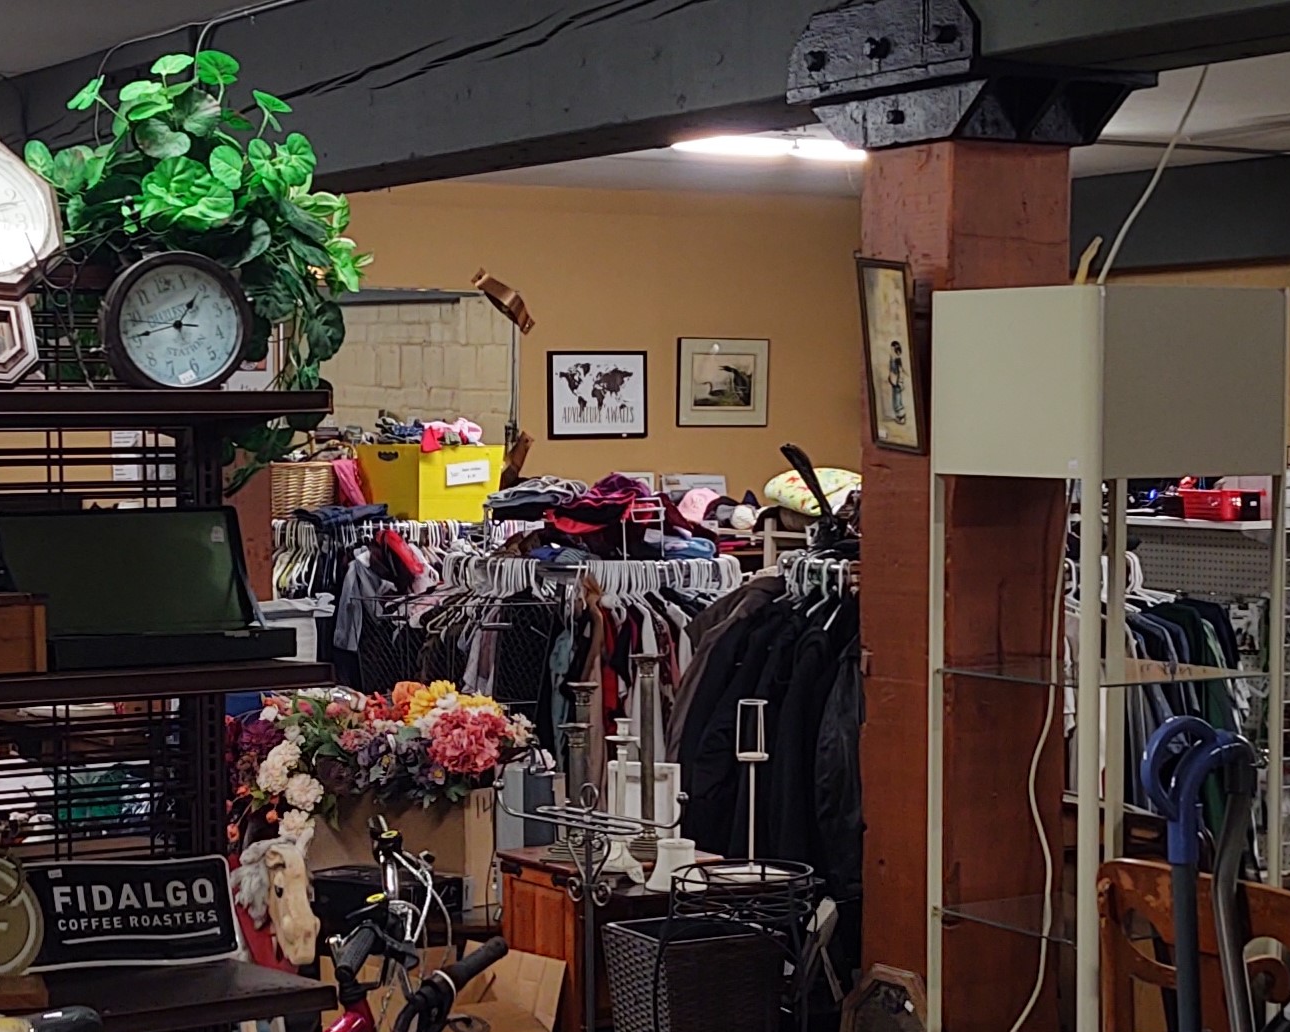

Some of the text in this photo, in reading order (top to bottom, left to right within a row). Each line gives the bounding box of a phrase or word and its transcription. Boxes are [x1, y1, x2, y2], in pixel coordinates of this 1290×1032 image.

[52, 877, 215, 913] FIDALGO
[57, 909, 218, 931] COFFEE ROASTERS
